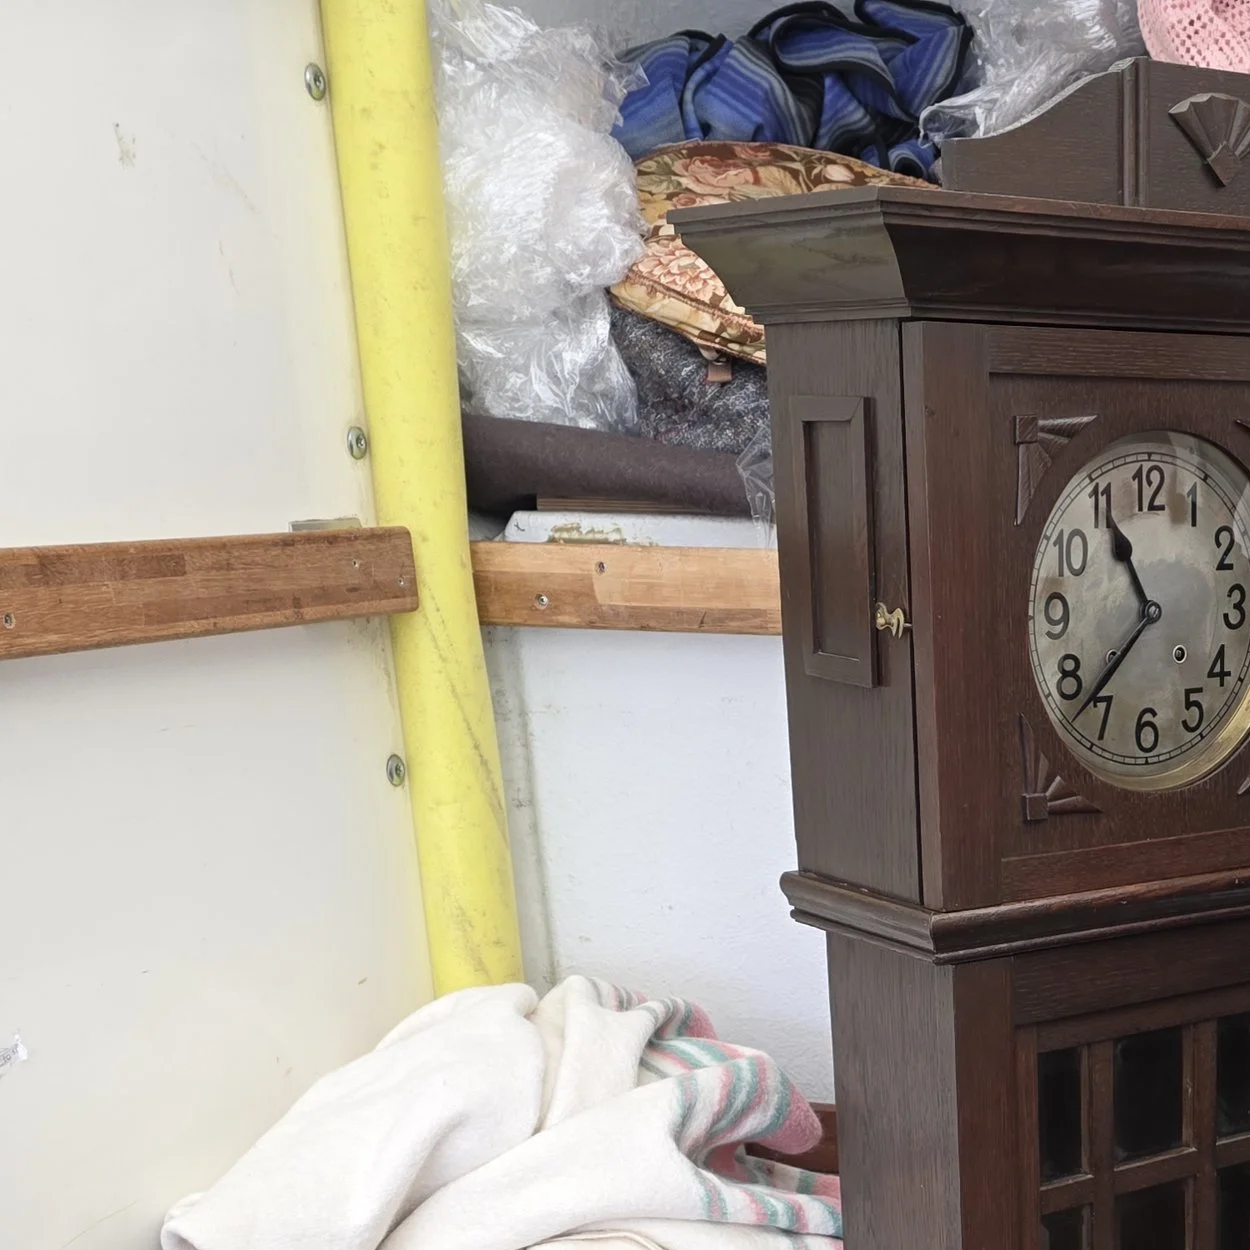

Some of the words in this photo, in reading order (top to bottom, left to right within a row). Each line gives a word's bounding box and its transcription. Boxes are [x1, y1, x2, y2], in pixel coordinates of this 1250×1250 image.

[1088, 482, 1113, 528] 11
[1131, 463, 1165, 512] 12
[1186, 482, 1197, 527] 1
[1052, 528, 1088, 577] 10
[1214, 525, 1235, 571] 2
[1044, 591, 1070, 640] 9
[1223, 583, 1246, 630] 3
[1056, 653, 1083, 700] 8
[1207, 643, 1231, 687] 4
[1093, 694, 1114, 740] 7
[1135, 707, 1159, 753] 6
[1181, 687, 1204, 733] 5
